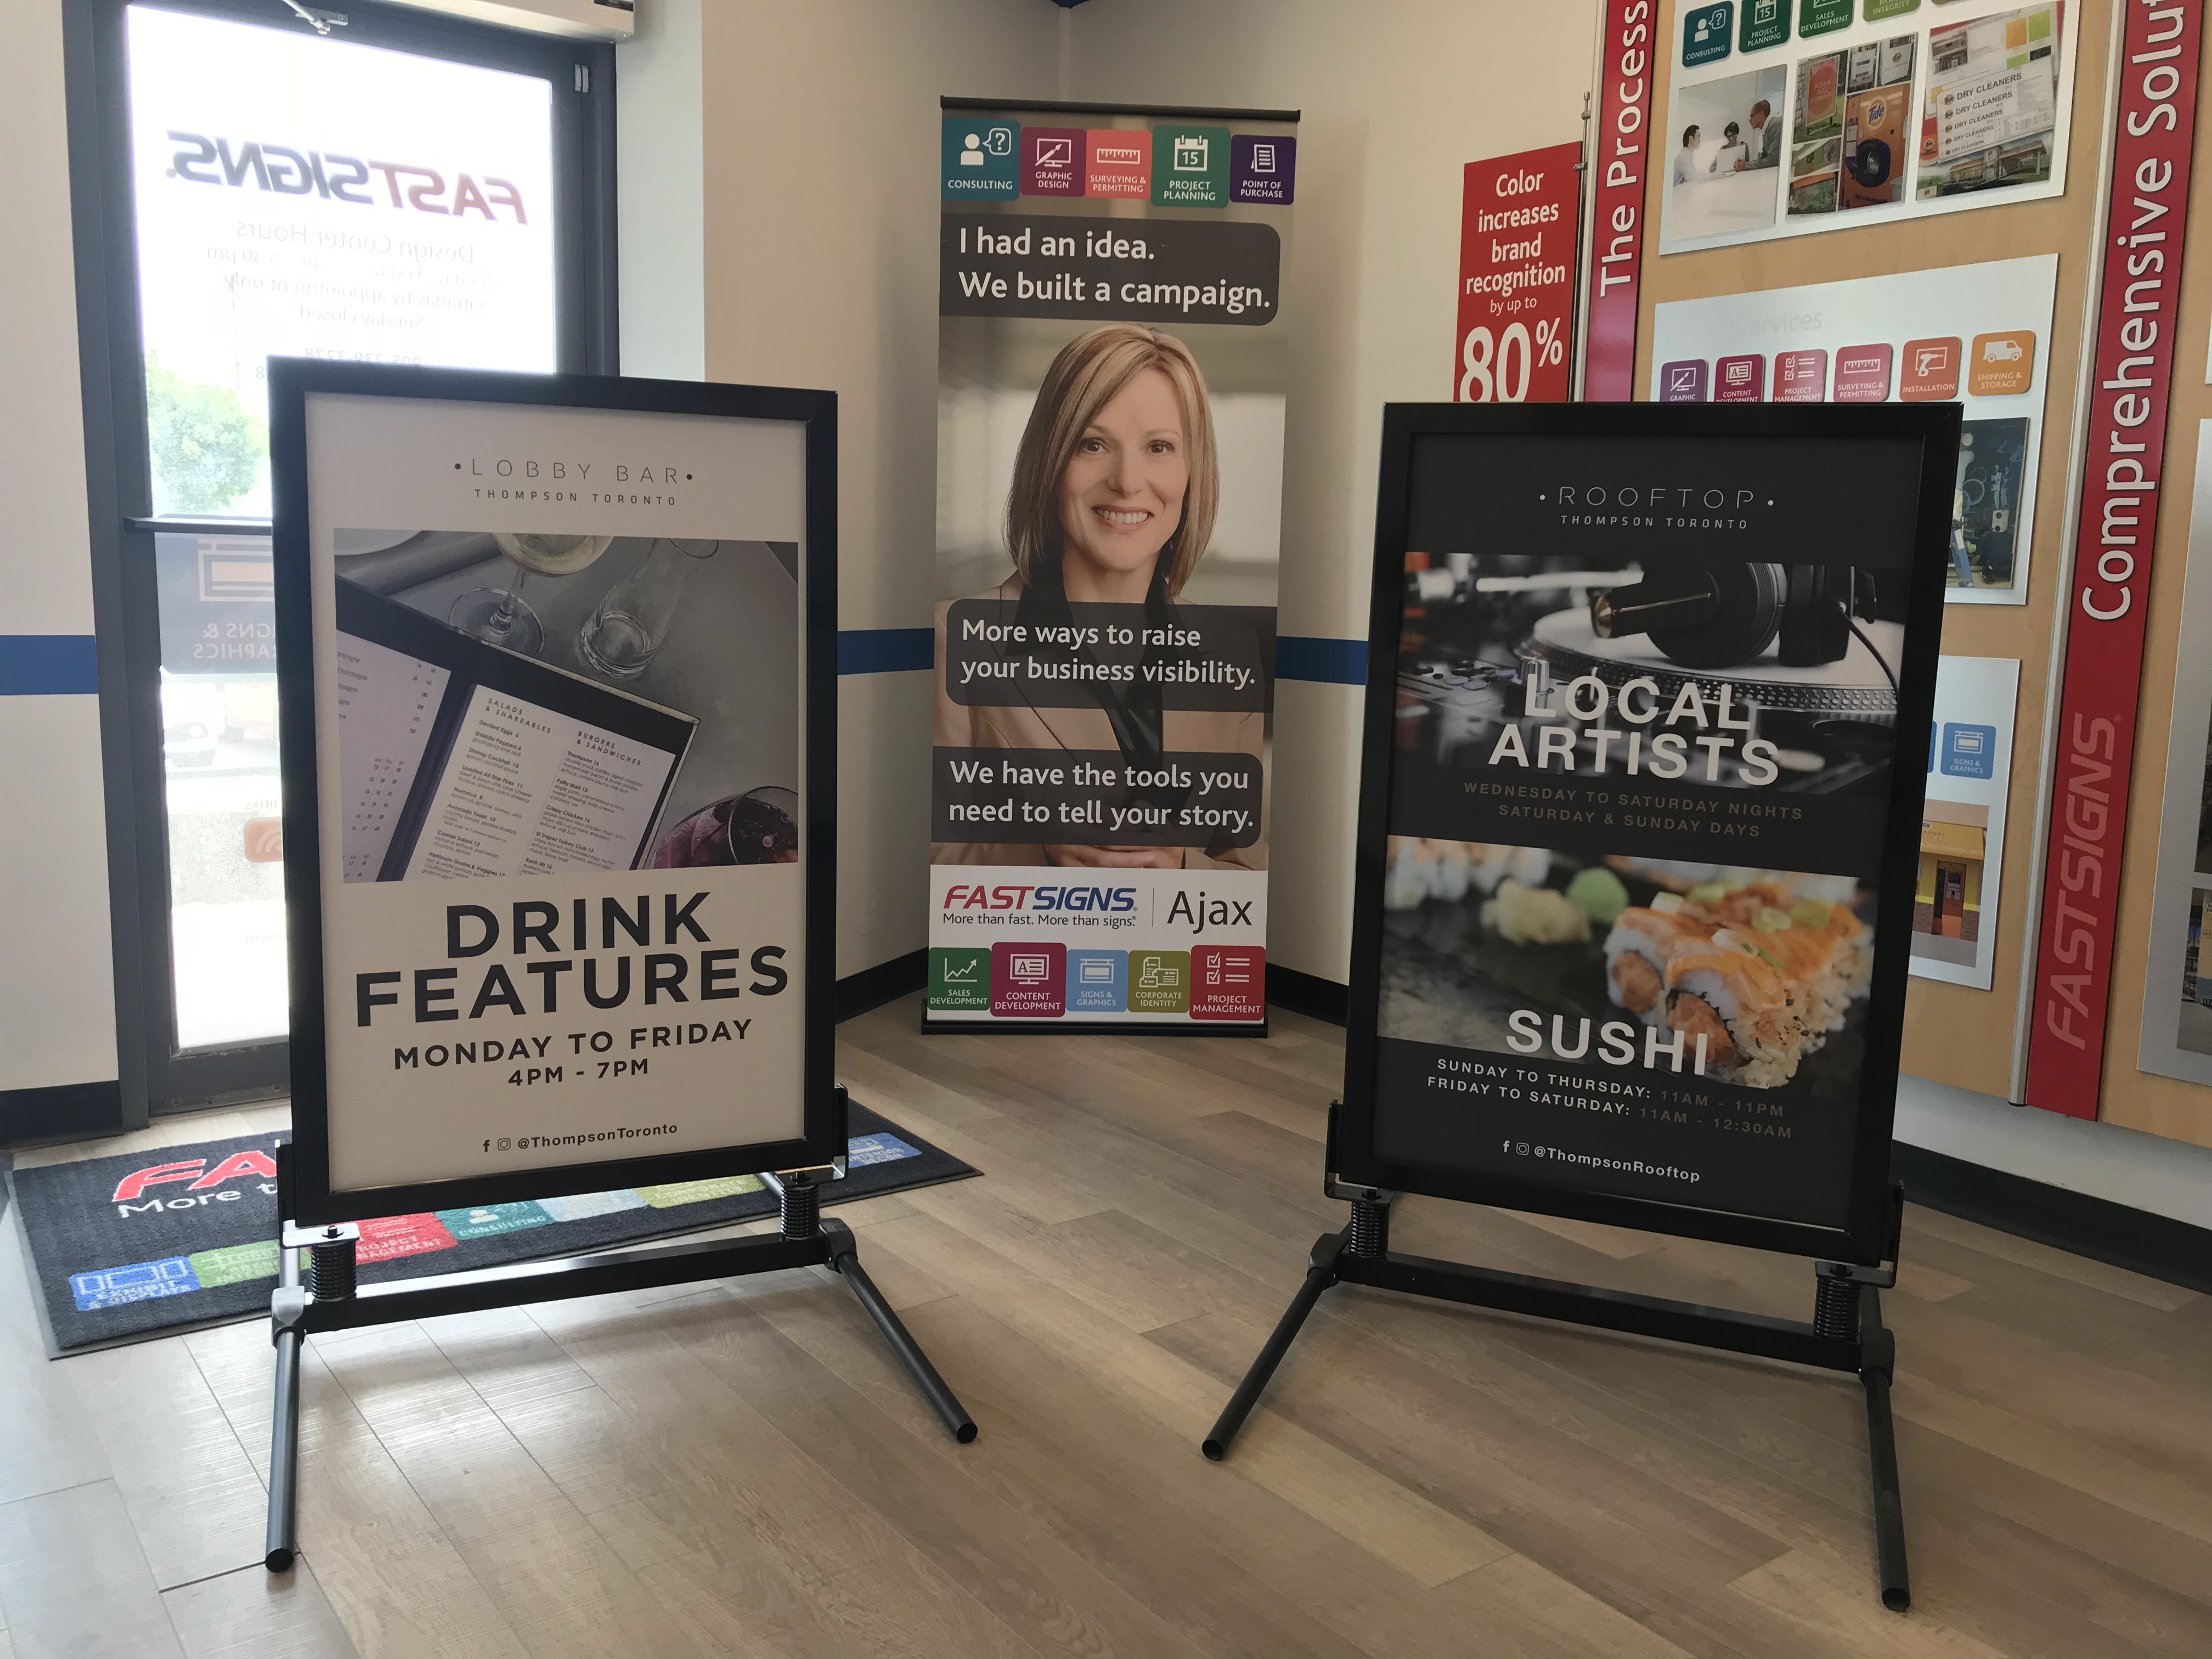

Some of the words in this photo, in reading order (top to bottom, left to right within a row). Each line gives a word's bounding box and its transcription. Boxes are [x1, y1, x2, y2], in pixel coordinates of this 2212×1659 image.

[1801, 15, 1849, 33] DEVELOPMENT
[1815, 11, 1835, 21] SALES
[1747, 32, 1781, 47] PLANNING
[1751, 25, 1779, 40] PROJECT
[1686, 45, 1726, 60] CONSULTING
[1606, 1, 1649, 188] Process
[1957, 88, 1974, 100] DRY
[1976, 72, 2022, 93] CLEANERS
[1956, 104, 1970, 115] DRY
[1972, 91, 2013, 110] CLEANERS
[1868, 104, 1885, 125] Tide
[1955, 119, 1967, 129] DRY
[1968, 109, 2004, 125] CLEANERS
[947, 179, 1013, 190] CONSULTING
[1035, 171, 1073, 180] GRAPHIC
[1038, 180, 1069, 189] DESIGN
[1090, 174, 1138, 184] SURVEYING
[1139, 176, 1147, 184] &
[1243, 179, 1266, 189] POINT
[1269, 180, 1282, 189] OF
[1496, 169, 1544, 198] Color
[1092, 183, 1143, 193] PERMITTING
[1164, 190, 1216, 201] PLANNING
[1170, 180, 1211, 192] PROJECT
[1240, 189, 1283, 199] PURCHASE
[1478, 203, 1559, 233] increases
[960, 228, 967, 253] I
[978, 227, 1031, 255] had
[1041, 234, 1075, 257] an
[1086, 230, 1155, 260] idea.
[1491, 232, 1542, 263] brand
[1600, 205, 1635, 297] The
[1466, 261, 1566, 297] recognition
[958, 271, 1007, 298] We
[1018, 271, 1086, 301] built
[1094, 282, 1111, 302] a
[1121, 279, 1271, 314] campaign.
[1490, 298, 1504, 317] by
[1507, 300, 1521, 315] up
[1525, 296, 1537, 309] to
[1459, 317, 1563, 402] 80%
[1977, 372, 2013, 381] SHIPPING
[2016, 371, 2023, 380] &
[1980, 380, 2017, 389] STORAGE
[1723, 390, 1752, 398] CONTENT
[1784, 387, 1812, 395] PROJECT
[1838, 382, 1877, 391] SURVEYING
[1839, 388, 1882, 398] PERMITTING
[1903, 383, 1955, 393] INSTALLATION
[2081, 158, 2172, 621] Comprehensive
[1670, 393, 1696, 402] GRAPHIC
[1774, 393, 1821, 402] MANAGEMENT
[472, 459, 591, 480] LOBBY
[617, 465, 678, 484] BAR
[475, 489, 577, 501] THOMPSON
[592, 493, 675, 505] TORONTO
[1559, 486, 1754, 510] ROOFTOP
[1561, 515, 1655, 527] THOMPSON
[1666, 517, 1748, 530] TORONTO
[962, 619, 1027, 642] More
[1035, 626, 1098, 650] ways
[1107, 625, 1133, 645] to
[1142, 624, 1201, 646] raise
[960, 660, 1020, 684] your
[1028, 656, 1135, 681] business
[1142, 660, 1255, 690] visibility.
[488, 698, 523, 715] SALADS
[1524, 673, 1752, 731] LOCAL
[495, 709, 551, 734] SHAREABLES
[578, 731, 616, 748] BURGERS
[585, 742, 641, 766] SANDWICHES
[1488, 724, 1779, 787] ARTISTS
[950, 761, 994, 783] We
[1002, 760, 1064, 785] have
[1073, 763, 1116, 786] the
[1125, 764, 1192, 788] tools
[1199, 771, 1248, 795] you
[1950, 764, 1983, 774] GRAPHICS
[1464, 782, 1578, 802] WEDNESDAY
[1585, 792, 1610, 805] TO
[1618, 794, 1719, 813] SATURDAY
[1729, 803, 1803, 821] NIGHTS
[949, 798, 1013, 822] need
[1022, 803, 1050, 822] to
[1058, 800, 1102, 823] tell
[1109, 807, 1171, 831] your
[1178, 805, 1254, 833] story.
[1498, 805, 1595, 824] SATURDAY
[1604, 812, 1615, 825] &
[1623, 814, 1702, 833] SUNDAY
[1710, 822, 1760, 838] DAYS
[943, 913, 974, 924] More
[977, 913, 1005, 925] than
[1008, 913, 1034, 926] fast.
[1038, 915, 1070, 926] More
[1073, 915, 1099, 927] than
[1167, 891, 1253, 934] Ajax
[447, 891, 712, 958] DRINK
[356, 945, 788, 1027] FEATURES
[1080, 990, 1104, 998] SIGNS
[1135, 991, 1183, 1000] CORPORATE
[930, 997, 988, 1006] DEVELOPMENT
[1006, 991, 1051, 1001] CONTENT
[1076, 998, 1117, 1007] GRAPHICS
[1140, 999, 1177, 1008] IDENTITY
[1207, 994, 1248, 1005] PROJECT
[995, 1001, 1061, 1011] DEVELOPMENT
[1193, 1004, 1262, 1014] MANAGEMENT
[394, 1035, 552, 1070] MONDAY
[568, 1031, 613, 1054] TO
[630, 1019, 752, 1049] FRIDAY
[1505, 1009, 1708, 1076] SUSHI
[507, 1065, 563, 1086] 4PM
[597, 1058, 649, 1079] 7PM
[1436, 1058, 1509, 1079] SUNDAY
[1516, 1069, 1539, 1083] TO
[1548, 1073, 1651, 1099] THURSDAY:
[1660, 1089, 1709, 1107] 11AM
[1735, 1100, 1785, 1117] 11PM
[1427, 1076, 1491, 1096] FRIDAY
[1498, 1086, 1521, 1101] TO
[1530, 1091, 1630, 1116] SATURDAY:
[1639, 1107, 1688, 1124] 11AM
[1713, 1118, 1792, 1139] 12:30AM
[517, 1123, 678, 1150] @ThompsonToronto
[1534, 1144, 1701, 1183] @ThompsonRooftop
[118, 1187, 242, 1218] More
